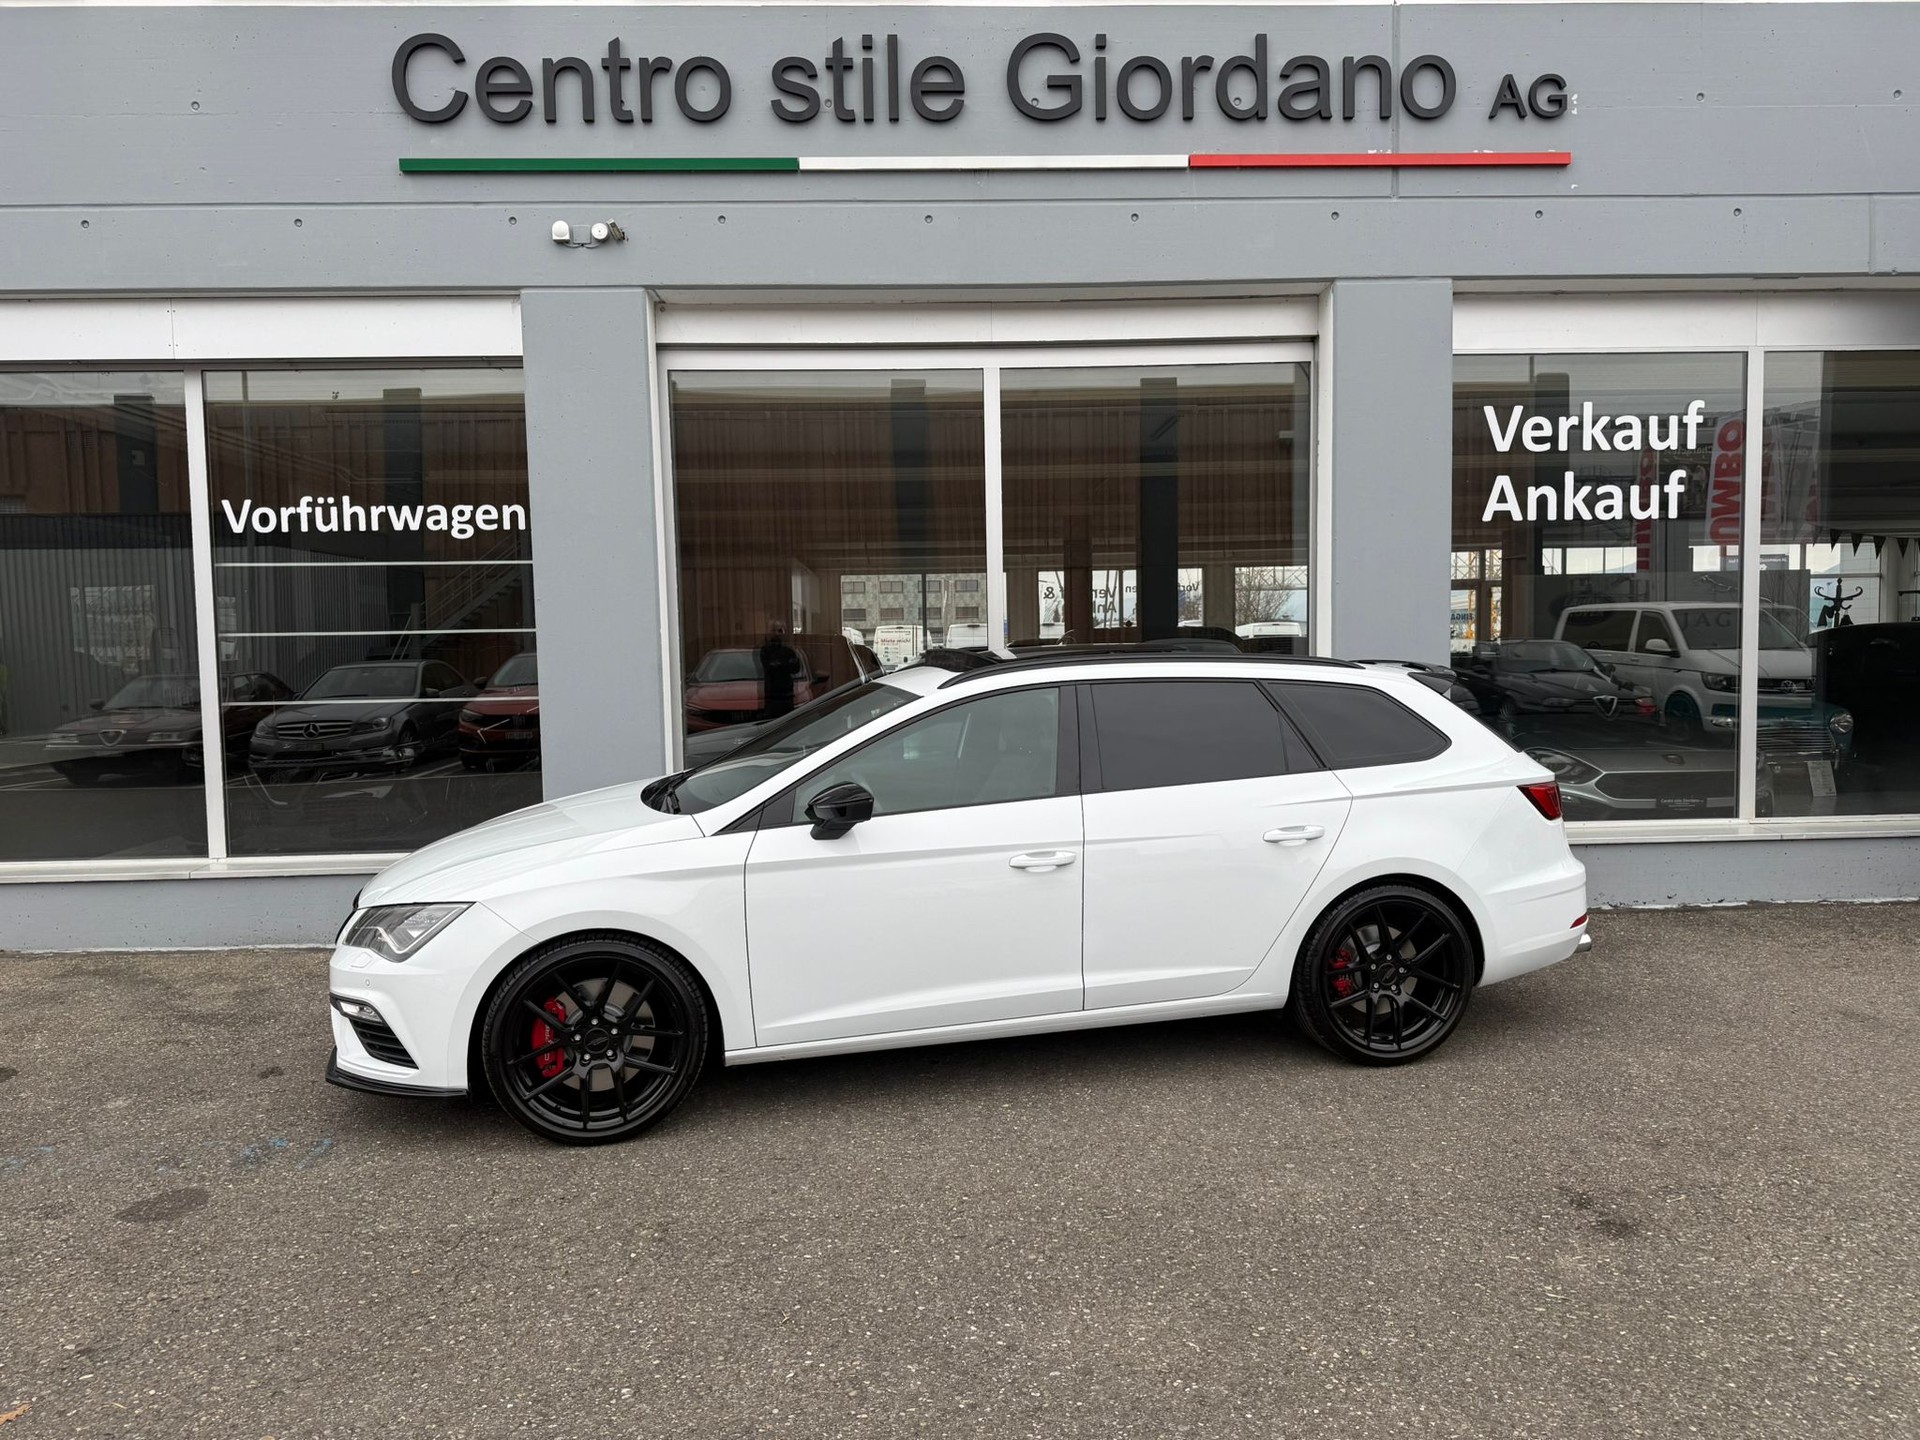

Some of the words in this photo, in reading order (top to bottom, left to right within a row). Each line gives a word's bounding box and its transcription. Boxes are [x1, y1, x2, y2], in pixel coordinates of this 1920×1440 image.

[392, 33, 732, 128] Centro
[771, 34, 966, 127] stile
[1006, 33, 1457, 126] Giordano
[1488, 74, 1568, 122] AG
[1484, 400, 1706, 452] Verkauf
[222, 496, 526, 539] Vorführwagen
[1482, 470, 1687, 521] Ankauf
